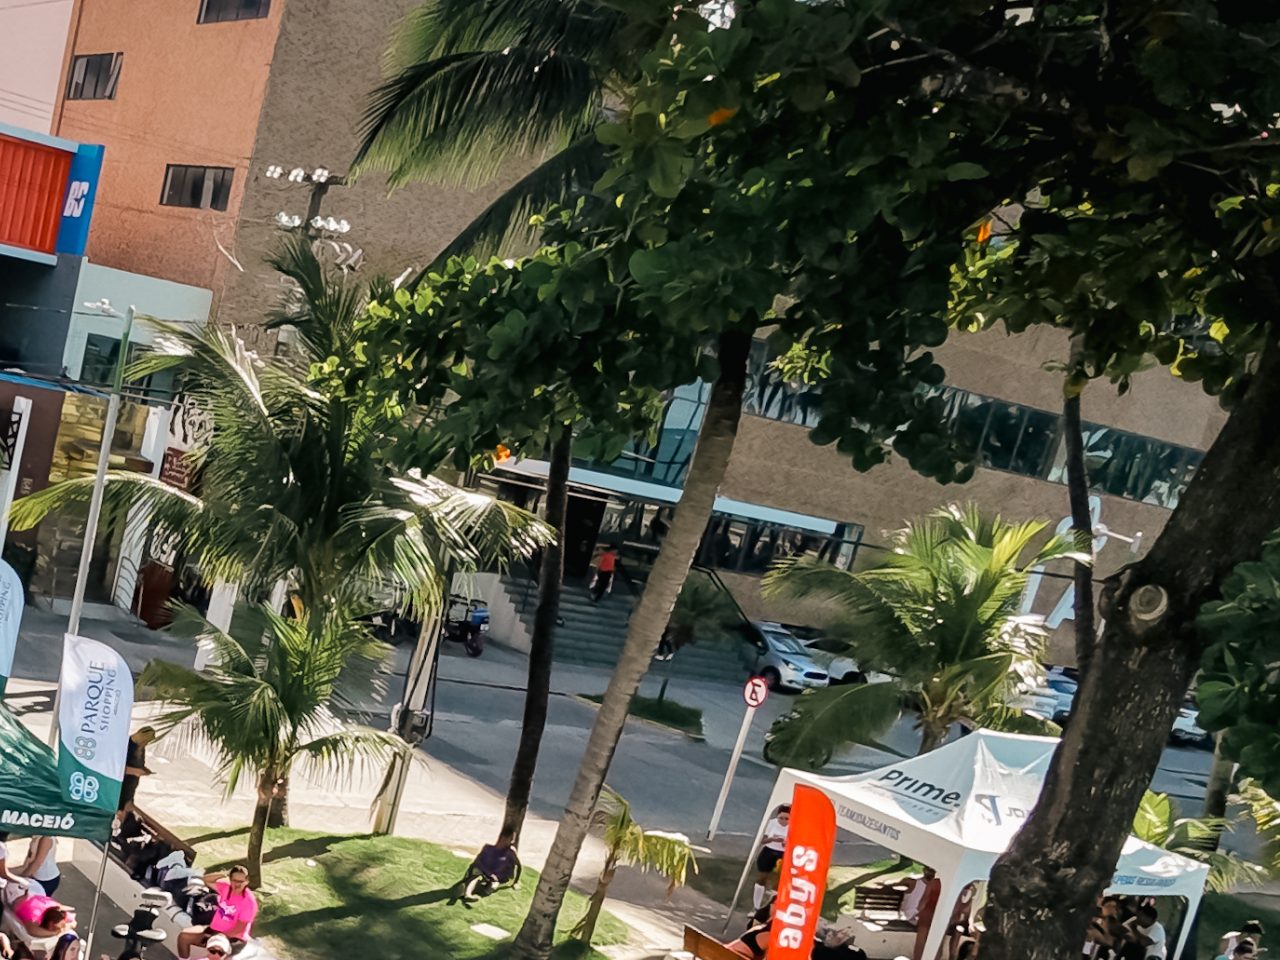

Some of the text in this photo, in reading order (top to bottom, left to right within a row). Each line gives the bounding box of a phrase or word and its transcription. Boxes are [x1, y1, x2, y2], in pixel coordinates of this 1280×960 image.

[80, 659, 106, 735] PARQUE
[99, 668, 118, 732] SHOPPING
[1, 809, 76, 831] MACEIÓ
[775, 845, 819, 950] aby's
